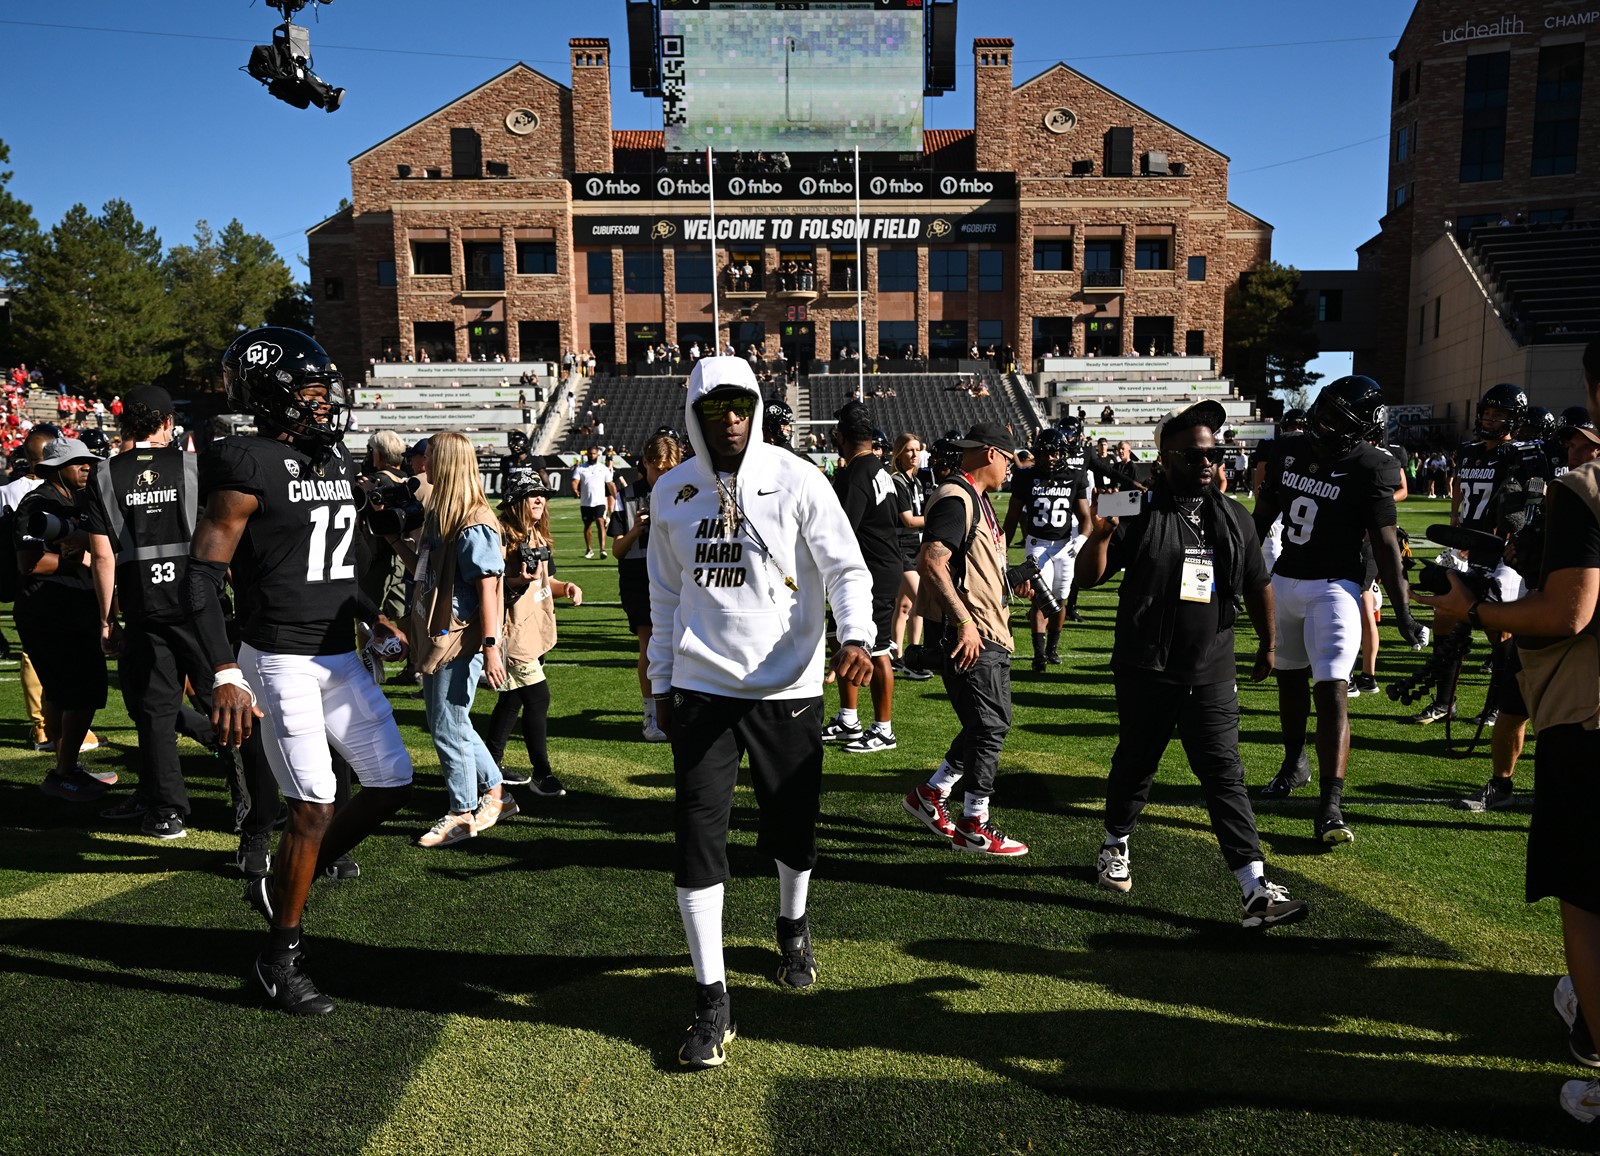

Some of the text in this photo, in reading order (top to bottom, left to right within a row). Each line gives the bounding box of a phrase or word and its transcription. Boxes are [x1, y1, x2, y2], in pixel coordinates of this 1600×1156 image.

[1442, 14, 1524, 43] uchealth
[606, 180, 640, 194] fnbo
[677, 180, 710, 194] fnbo
[748, 179, 782, 193] fnbo
[818, 179, 853, 193] fnbo
[889, 178, 923, 193] fnbo
[959, 178, 993, 193] fnbo
[592, 225, 640, 235] CUBUFFS.COM
[684, 218, 920, 240] WELCOME TO FOLSOM FIELD
[961, 223, 996, 233] #GOBUFFS
[788, 306, 806, 320] 25
[1459, 468, 1495, 480] COLORADO
[288, 478, 354, 503] COLORAD
[1032, 486, 1071, 496] COLORADO
[1282, 470, 1340, 500] COLORADO
[126, 488, 177, 506] CREATIVE
[1032, 497, 1070, 528] 36
[1287, 496, 1318, 545] 9
[694, 518, 744, 539] AINT
[307, 504, 356, 582] 12
[694, 542, 743, 563] HARD
[151, 561, 176, 584] 33
[694, 567, 746, 588] 2 FIND
